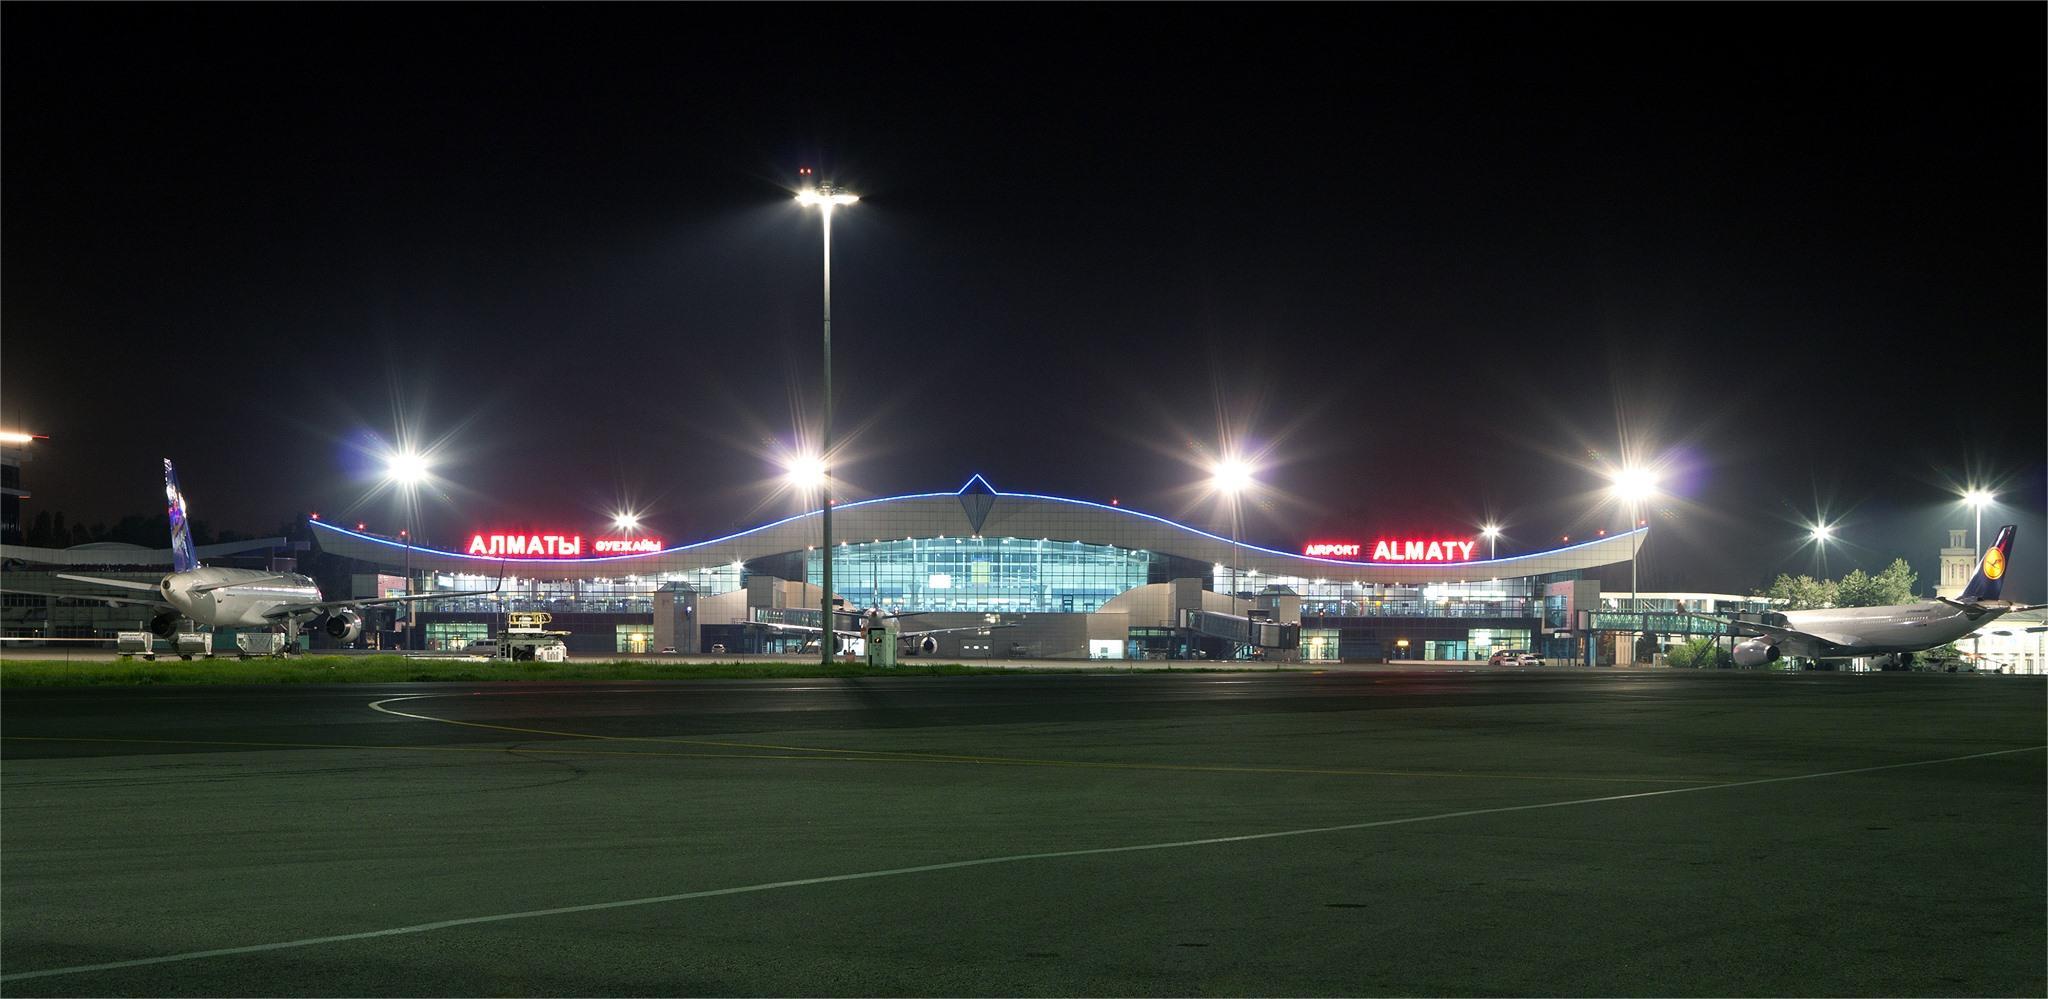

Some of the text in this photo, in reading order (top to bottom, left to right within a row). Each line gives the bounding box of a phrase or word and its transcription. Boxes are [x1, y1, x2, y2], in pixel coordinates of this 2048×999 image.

[469, 535, 580, 555] АЛМАТЫ
[1305, 541, 1475, 560] AIRPORT ALMATY
